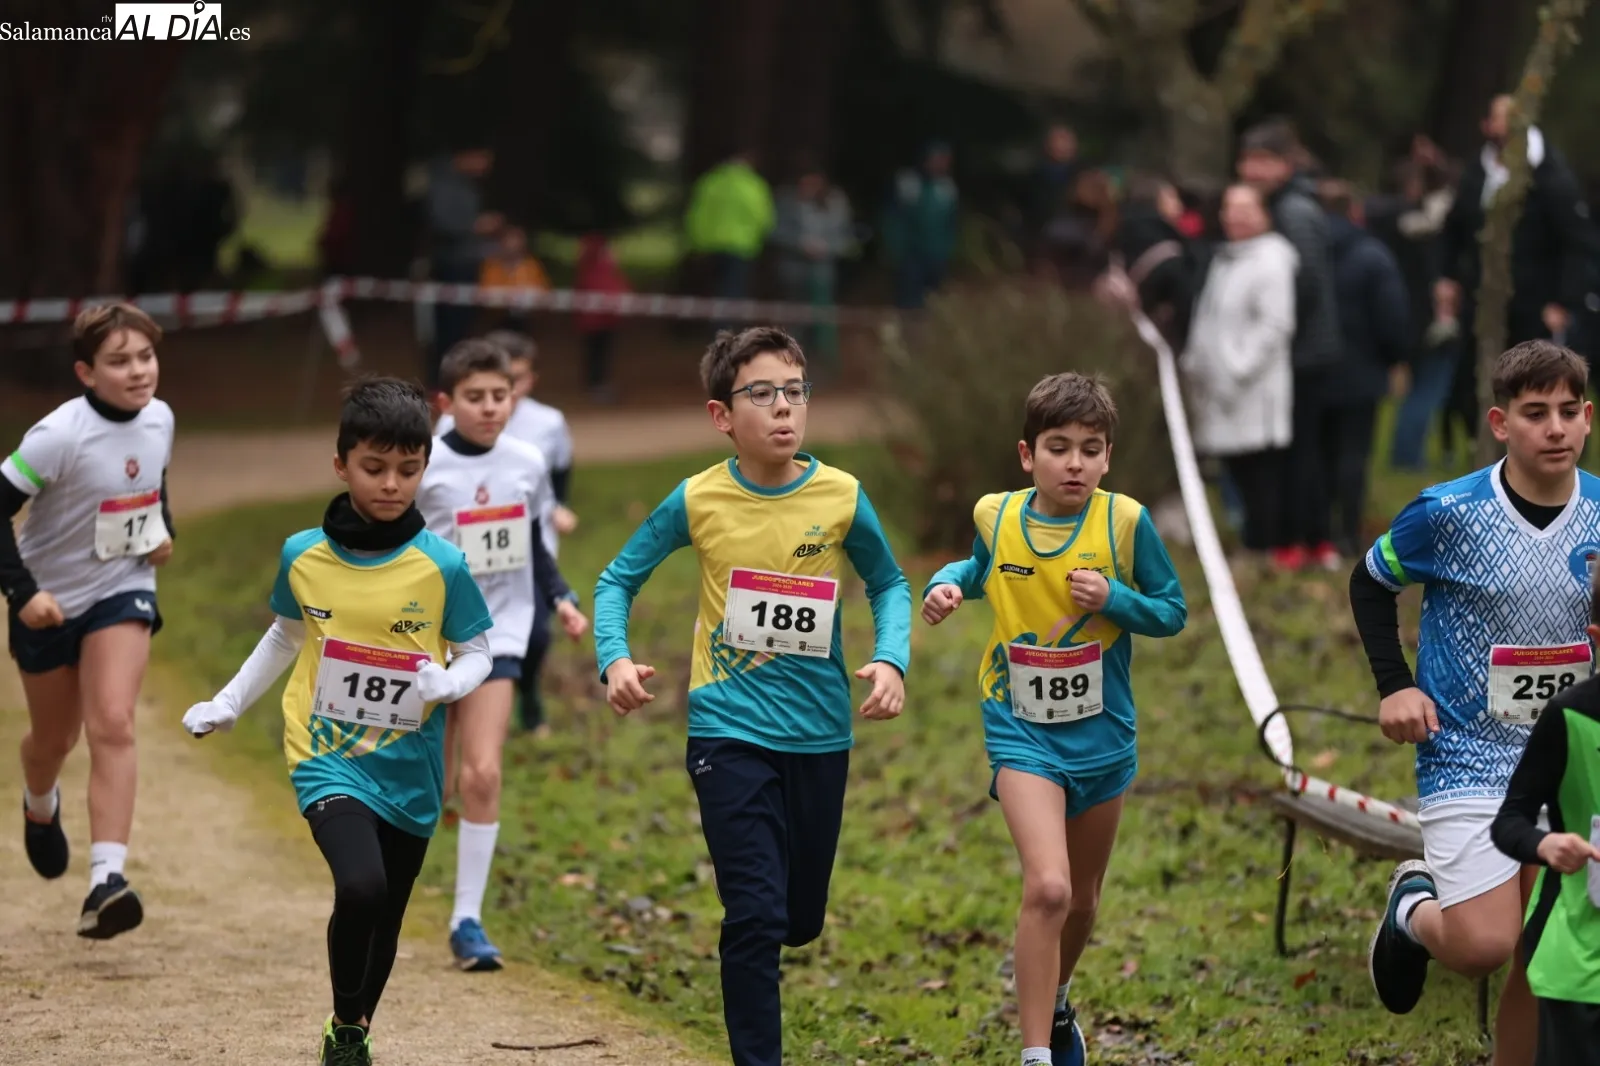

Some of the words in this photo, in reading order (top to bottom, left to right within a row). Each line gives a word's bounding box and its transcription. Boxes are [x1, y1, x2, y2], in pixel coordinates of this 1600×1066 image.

[124, 514, 148, 538] 17
[481, 528, 510, 551] 18
[751, 600, 816, 634] 188
[343, 672, 412, 705] 187
[1028, 673, 1090, 701] 189
[1512, 672, 1576, 700] 258
